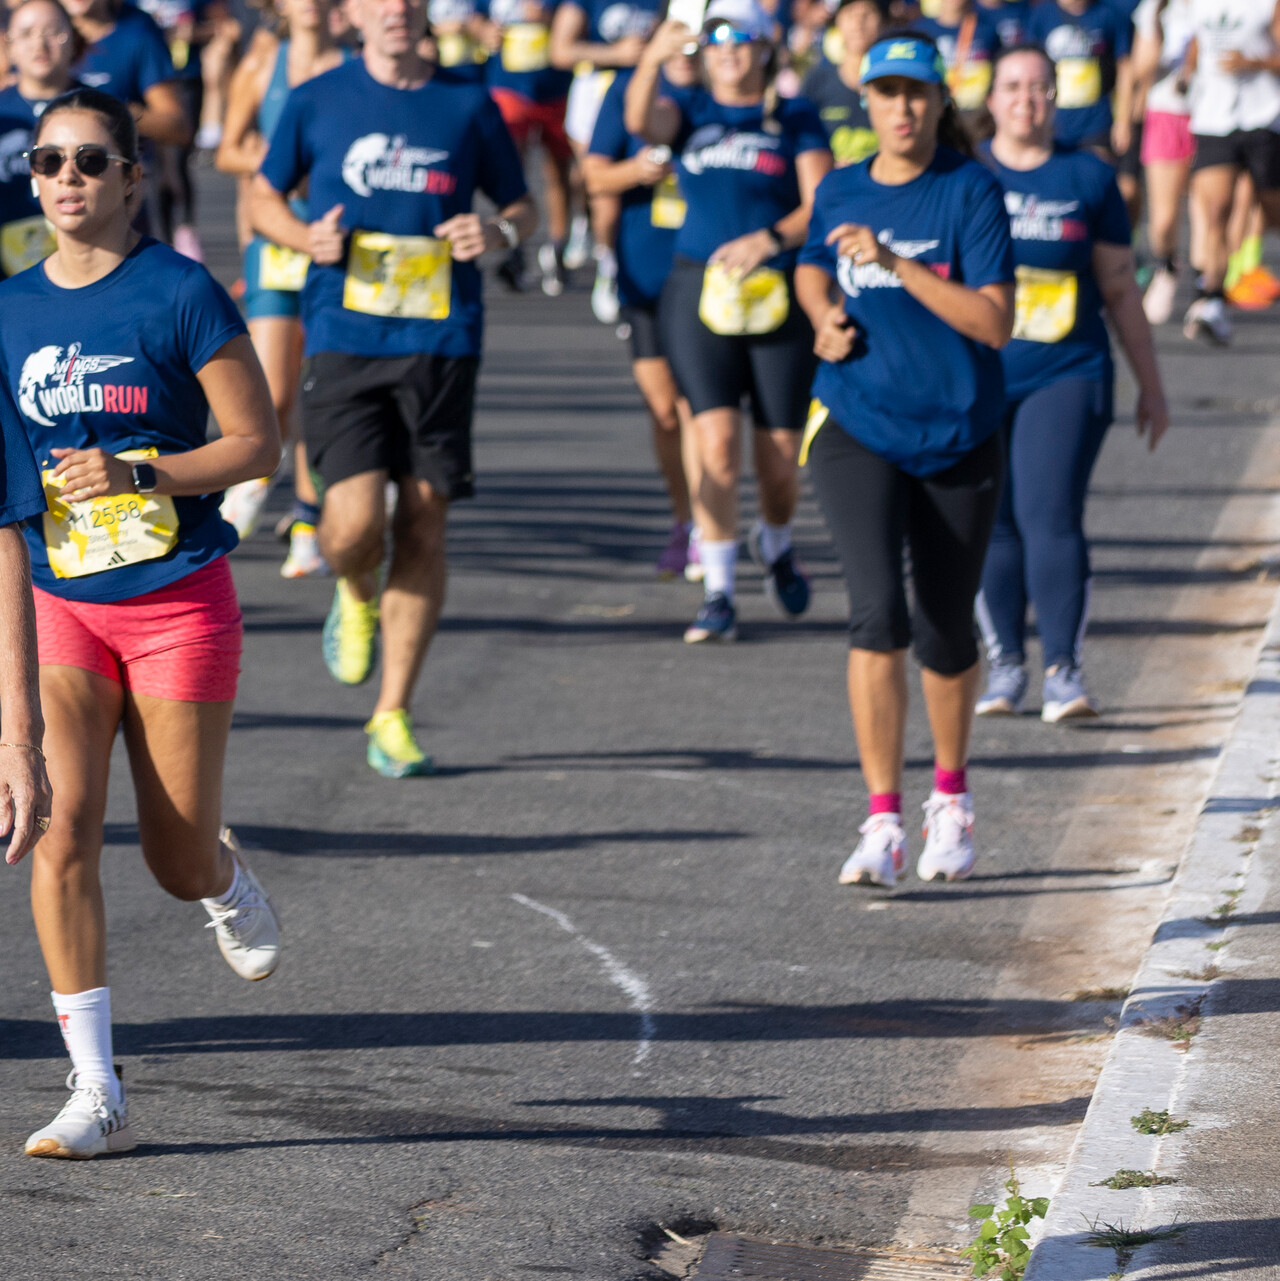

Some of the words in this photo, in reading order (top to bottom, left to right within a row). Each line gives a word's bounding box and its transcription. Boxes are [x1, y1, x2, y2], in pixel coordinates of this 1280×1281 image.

[55, 354, 100, 373] WINGS
[59, 371, 86, 387] LIFE
[38, 383, 148, 417] WORLDRUN
